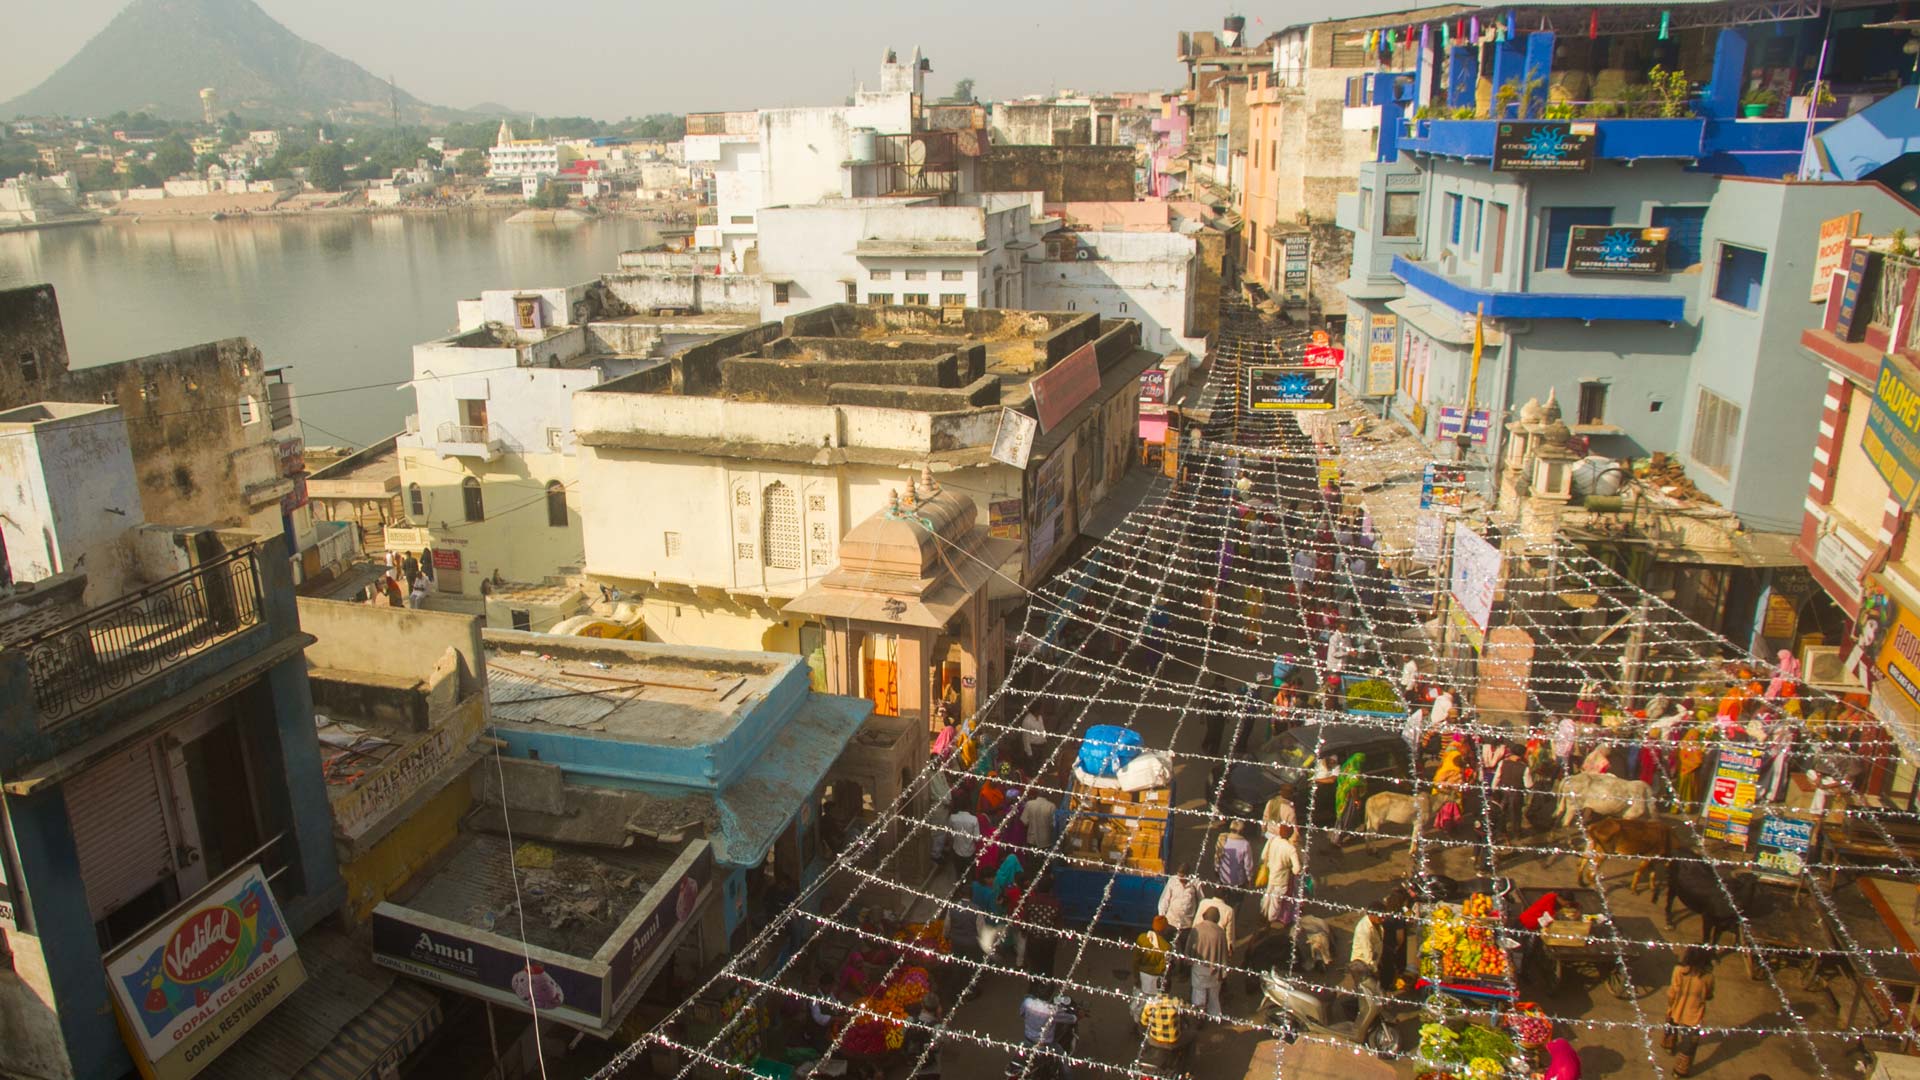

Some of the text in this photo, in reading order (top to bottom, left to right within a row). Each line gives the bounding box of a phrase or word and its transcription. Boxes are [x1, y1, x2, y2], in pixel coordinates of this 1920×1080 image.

[166, 909, 236, 977] Vadilal
[415, 931, 475, 964] Amul
[631, 912, 660, 961] Amul
[173, 954, 279, 1041] GOPAL ICE CREAM
[185, 976, 281, 1063] GOPAL RESTAURANT
